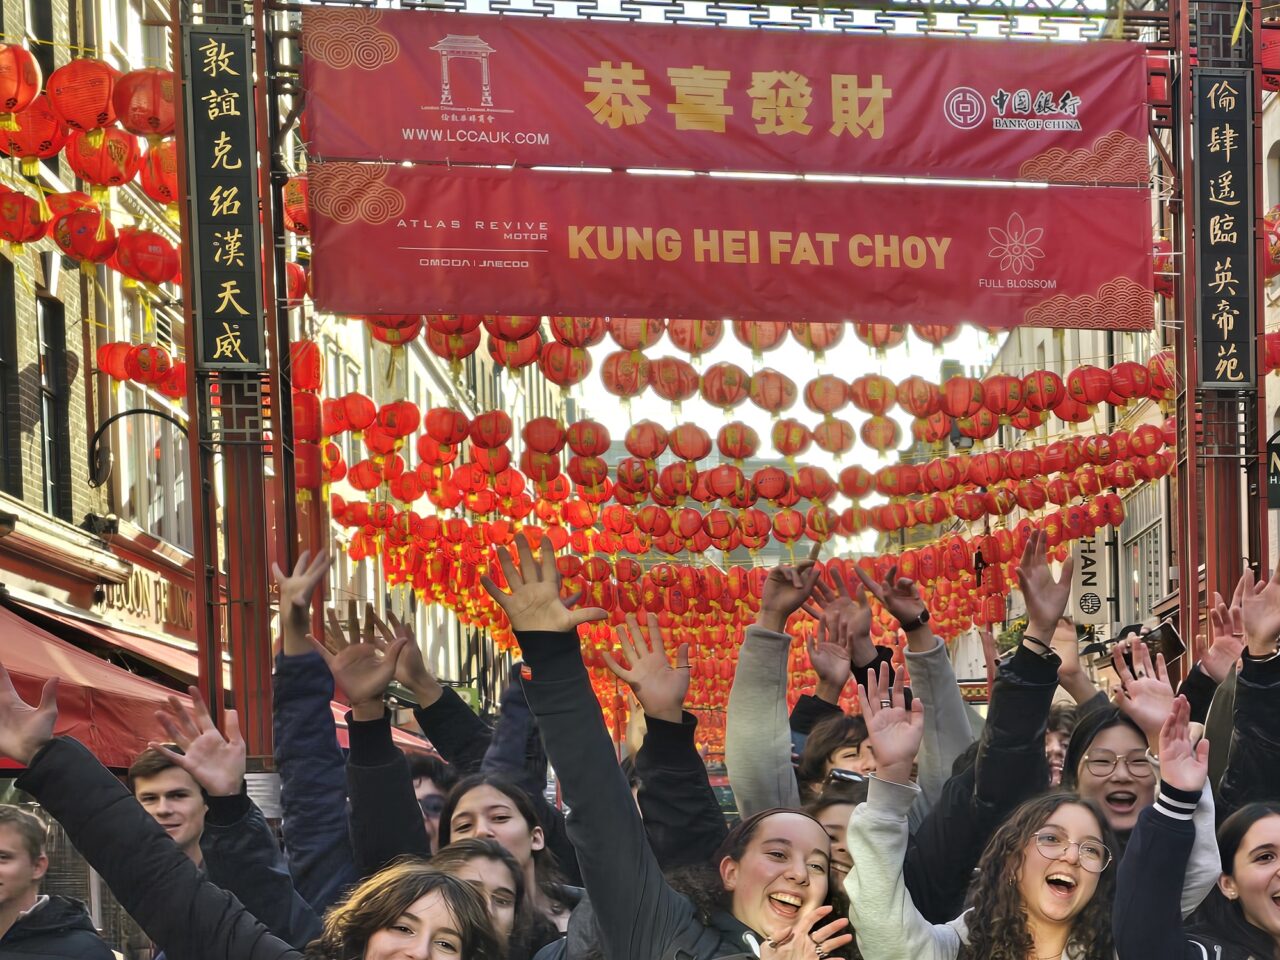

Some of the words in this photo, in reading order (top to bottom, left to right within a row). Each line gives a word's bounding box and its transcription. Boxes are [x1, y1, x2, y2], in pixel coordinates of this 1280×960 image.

[584, 60, 892, 139] 恭喜發財
[993, 118, 1025, 129] BANK
[1027, 119, 1041, 130] OF
[1044, 119, 1082, 130] CHINA
[402, 128, 550, 145] WWW.LCCAUK.COM
[397, 219, 461, 229] ATLAS
[475, 220, 549, 231] REVIVE
[503, 233, 548, 241] MOTOR
[568, 225, 682, 261] KUNG
[694, 228, 759, 264] HEI
[769, 231, 839, 266] FAT
[848, 234, 952, 270] CHOY
[419, 258, 471, 267] OMODA
[478, 260, 529, 268] JAECOO
[979, 278, 1004, 288] FULL
[1007, 279, 1057, 289] BLOSSOM
